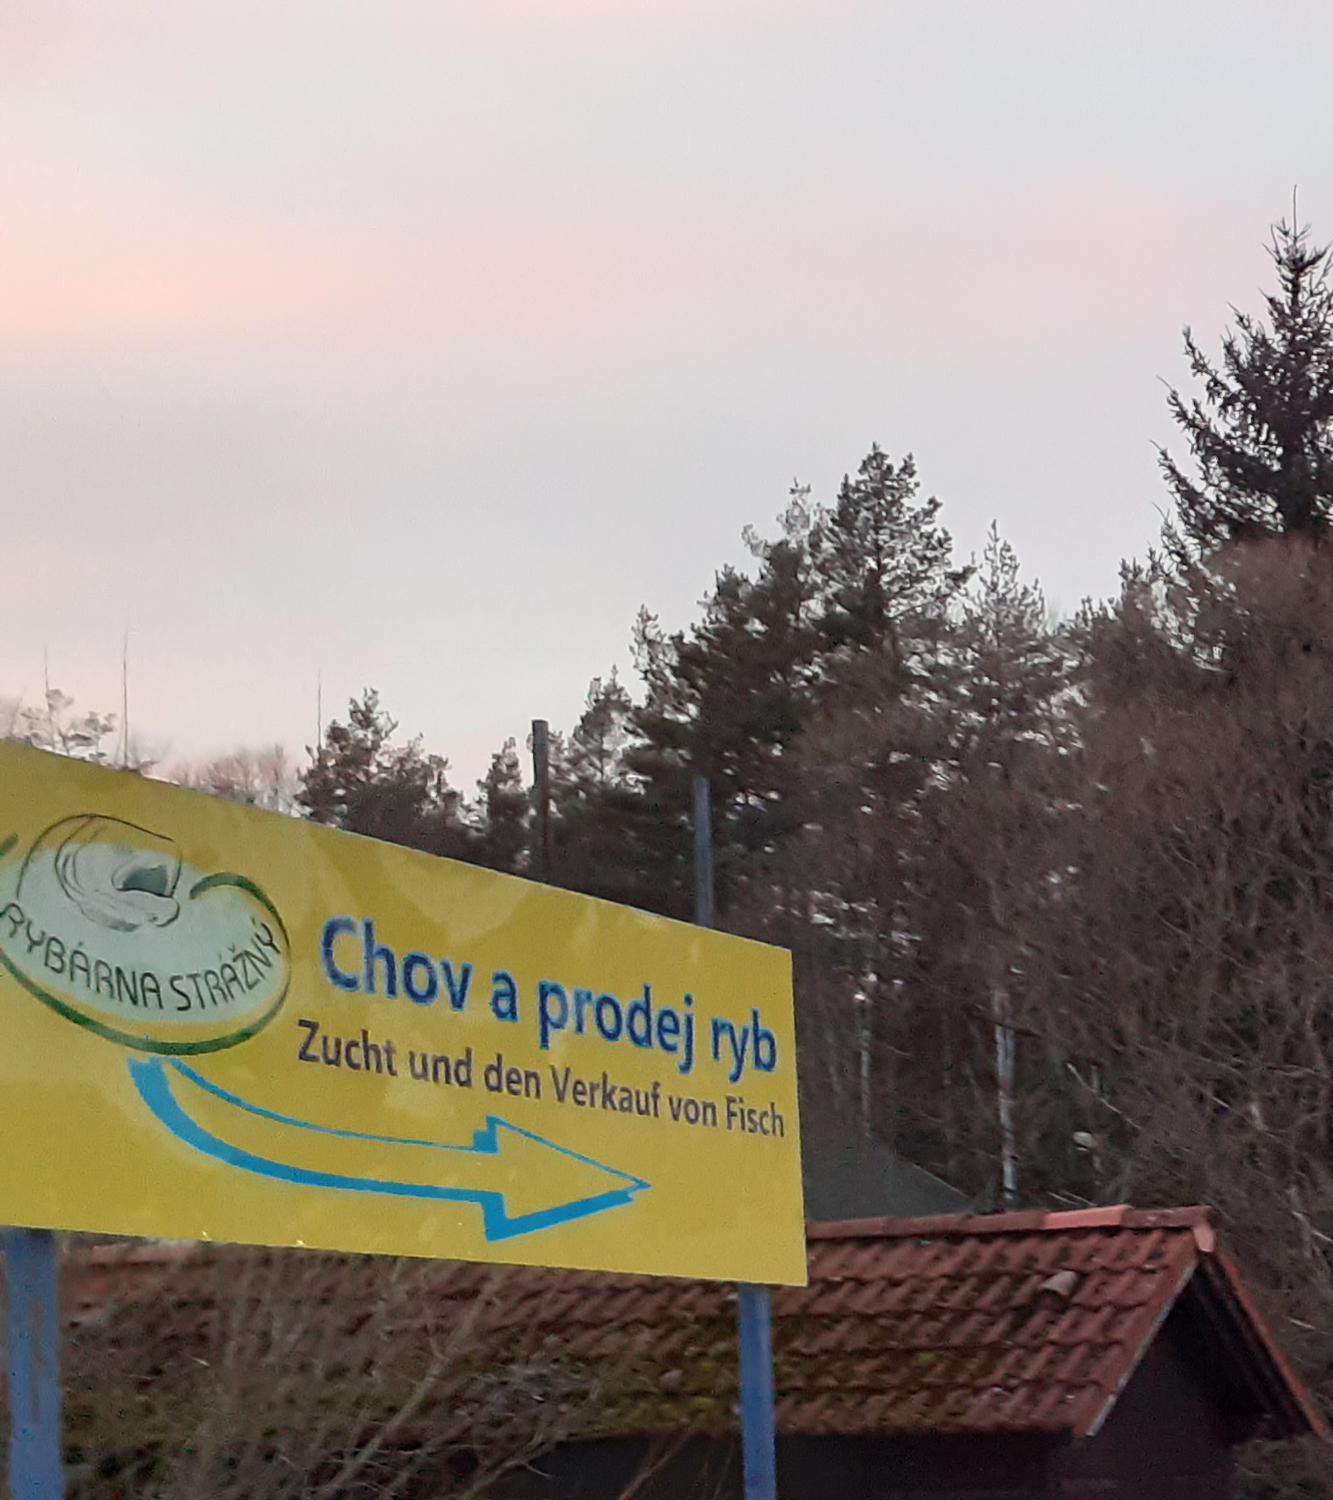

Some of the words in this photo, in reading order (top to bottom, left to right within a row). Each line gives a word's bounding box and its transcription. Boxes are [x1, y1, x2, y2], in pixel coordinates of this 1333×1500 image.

[0, 902, 163, 1010] RYBÁRNA
[169, 916, 281, 1011] STRÁŽNÝ
[320, 915, 473, 1012] Chov
[490, 969, 520, 1023] a
[538, 979, 694, 1075] prodej
[711, 1008, 778, 1084] ryb
[298, 1019, 398, 1076] Zucht
[409, 1047, 472, 1088] und
[484, 1053, 541, 1100] den
[551, 1065, 660, 1118] Verkauf
[669, 1095, 717, 1127] von
[726, 1095, 785, 1138] Fisch
